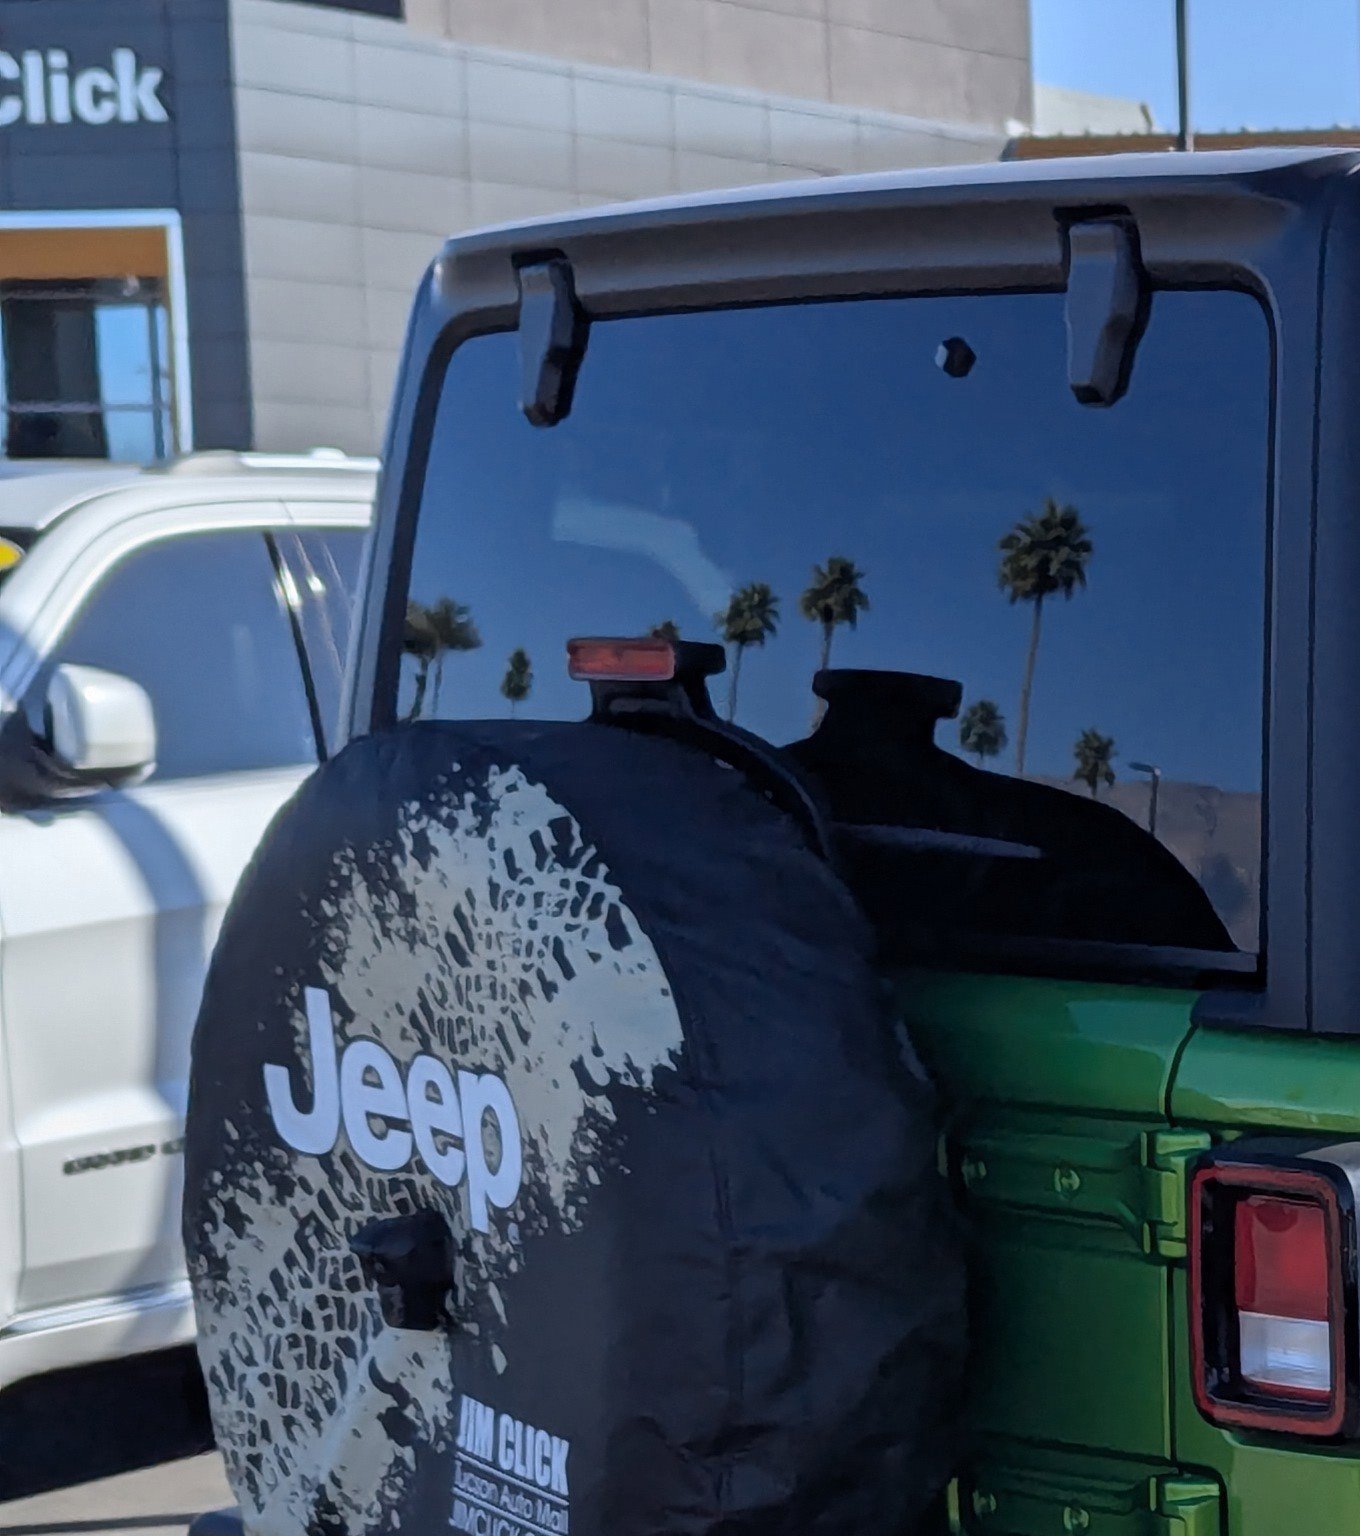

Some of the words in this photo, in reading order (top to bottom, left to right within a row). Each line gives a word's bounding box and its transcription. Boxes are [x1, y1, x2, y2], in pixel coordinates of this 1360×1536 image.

[0, 47, 169, 126] Click
[263, 985, 522, 1234] Jeep
[456, 1394, 495, 1462] JIM
[498, 1413, 570, 1496] CLICK
